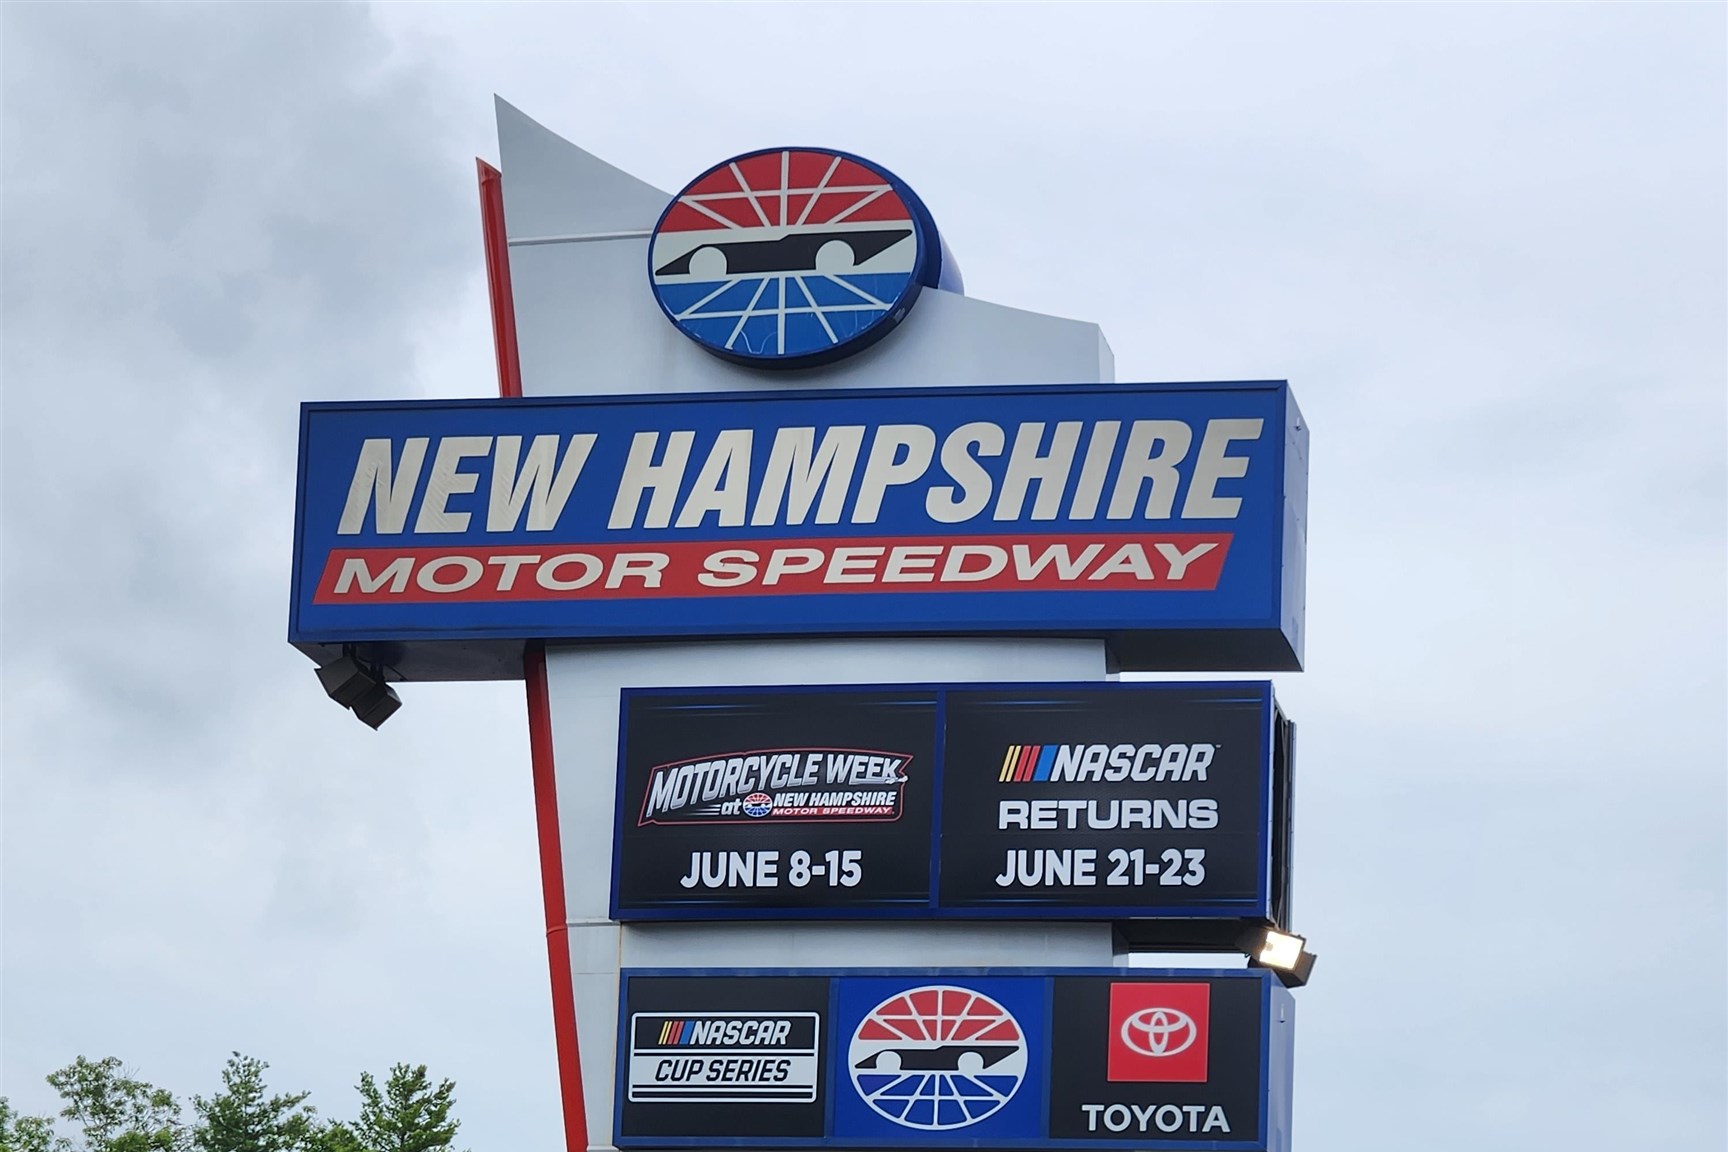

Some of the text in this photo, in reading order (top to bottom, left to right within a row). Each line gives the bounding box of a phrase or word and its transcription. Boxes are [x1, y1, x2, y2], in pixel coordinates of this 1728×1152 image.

[337, 417, 1264, 536] NEW HAMPSHIRE
[332, 541, 1219, 595] MOTOR SPEEDWAY
[1050, 743, 1216, 782] NASCAR
[646, 753, 902, 817] MOTORCYCLE WEEK
[721, 791, 897, 815] at NEW HAMPSHIRE
[771, 806, 890, 815] MOTOR SPEEDWAY
[999, 799, 1219, 829] RETURNS
[680, 850, 862, 888] JUNE 8-15
[995, 849, 1206, 886] JUNE 21-23
[690, 1020, 792, 1045] NASCAR
[655, 1059, 791, 1082] CUP SERIES
[1082, 1104, 1231, 1133] TOYOTA
